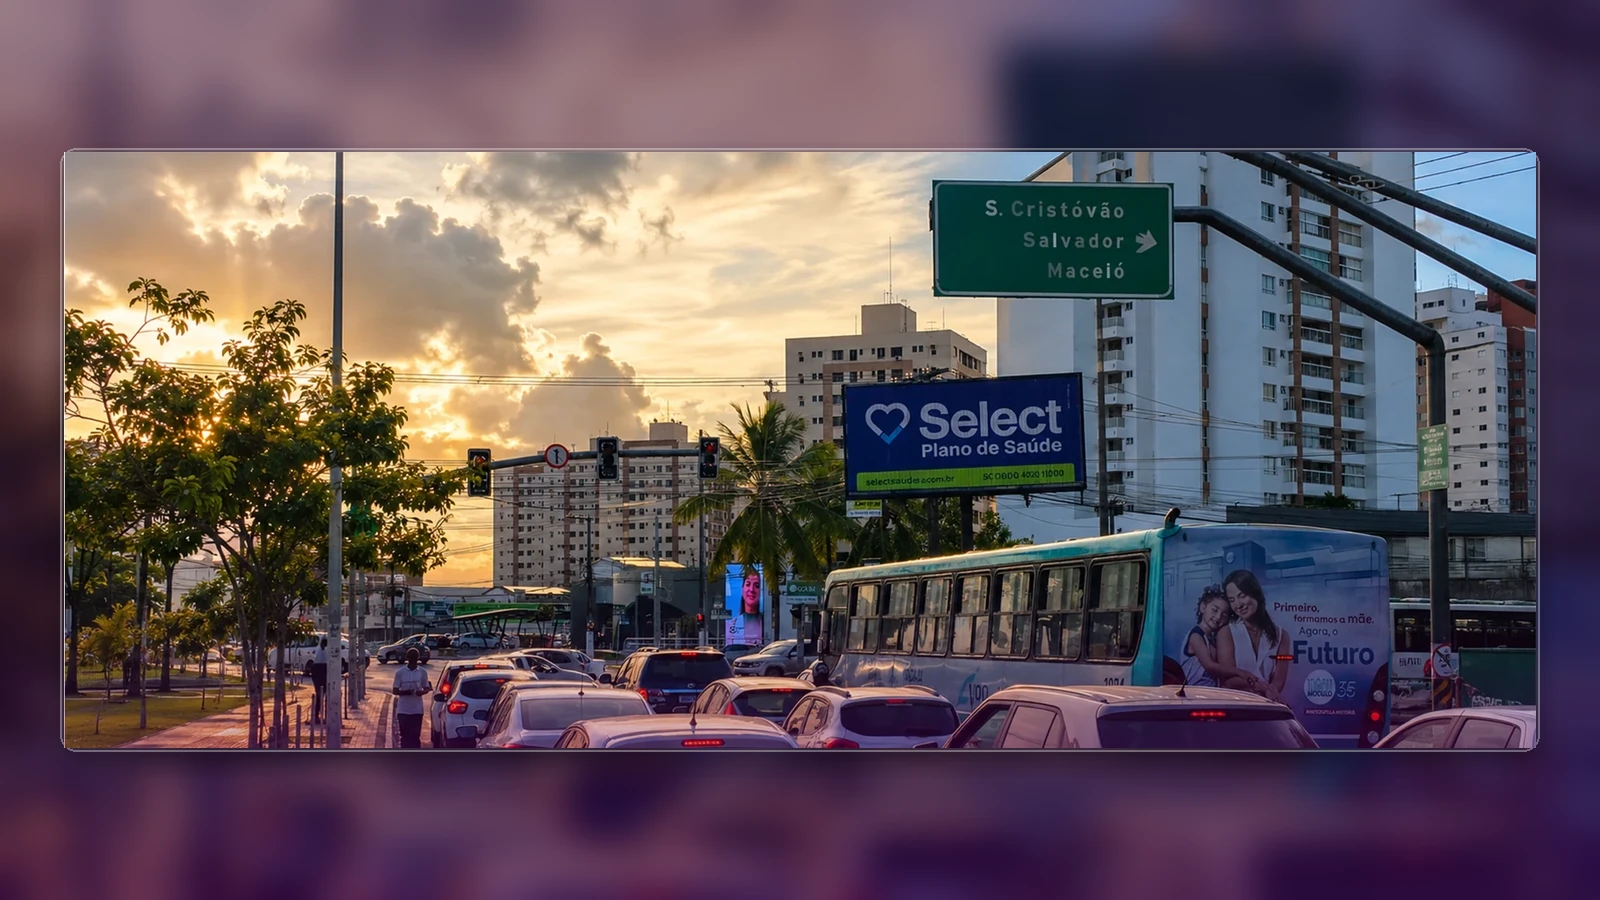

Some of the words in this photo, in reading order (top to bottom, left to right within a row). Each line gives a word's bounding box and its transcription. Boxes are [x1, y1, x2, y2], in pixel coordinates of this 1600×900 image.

[985, 199, 1003, 217] S.
[1011, 200, 1125, 219] Cristóvão
[1023, 231, 1125, 249] Salvador
[1048, 262, 1125, 279] Maceió
[919, 399, 1063, 440] Select
[921, 441, 972, 458] Plano
[976, 440, 1000, 455] de
[1004, 438, 1063, 454] Saúde
[1273, 602, 1320, 613] Primeiro,
[1293, 614, 1338, 624] formamos
[1347, 613, 1375, 624] mãe.
[1298, 626, 1331, 638] Agora,
[1292, 640, 1375, 665] Futuro
